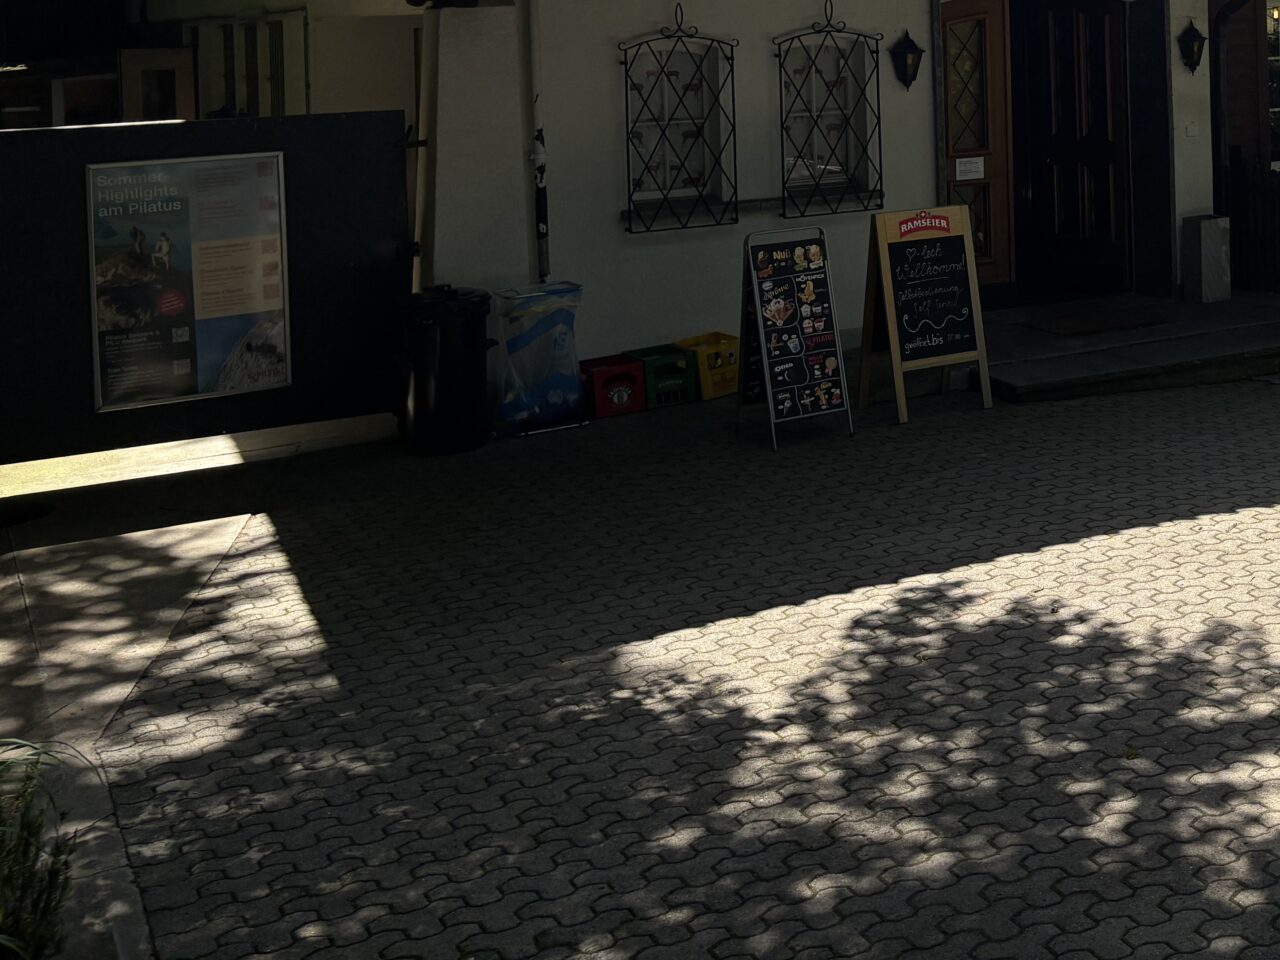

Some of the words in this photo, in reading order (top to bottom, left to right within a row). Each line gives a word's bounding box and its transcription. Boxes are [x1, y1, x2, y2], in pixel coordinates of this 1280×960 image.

[98, 184, 179, 204] Highlights
[98, 206, 123, 217] am
[128, 200, 182, 215] Pilatus
[901, 218, 947, 233] RAMSEIER
